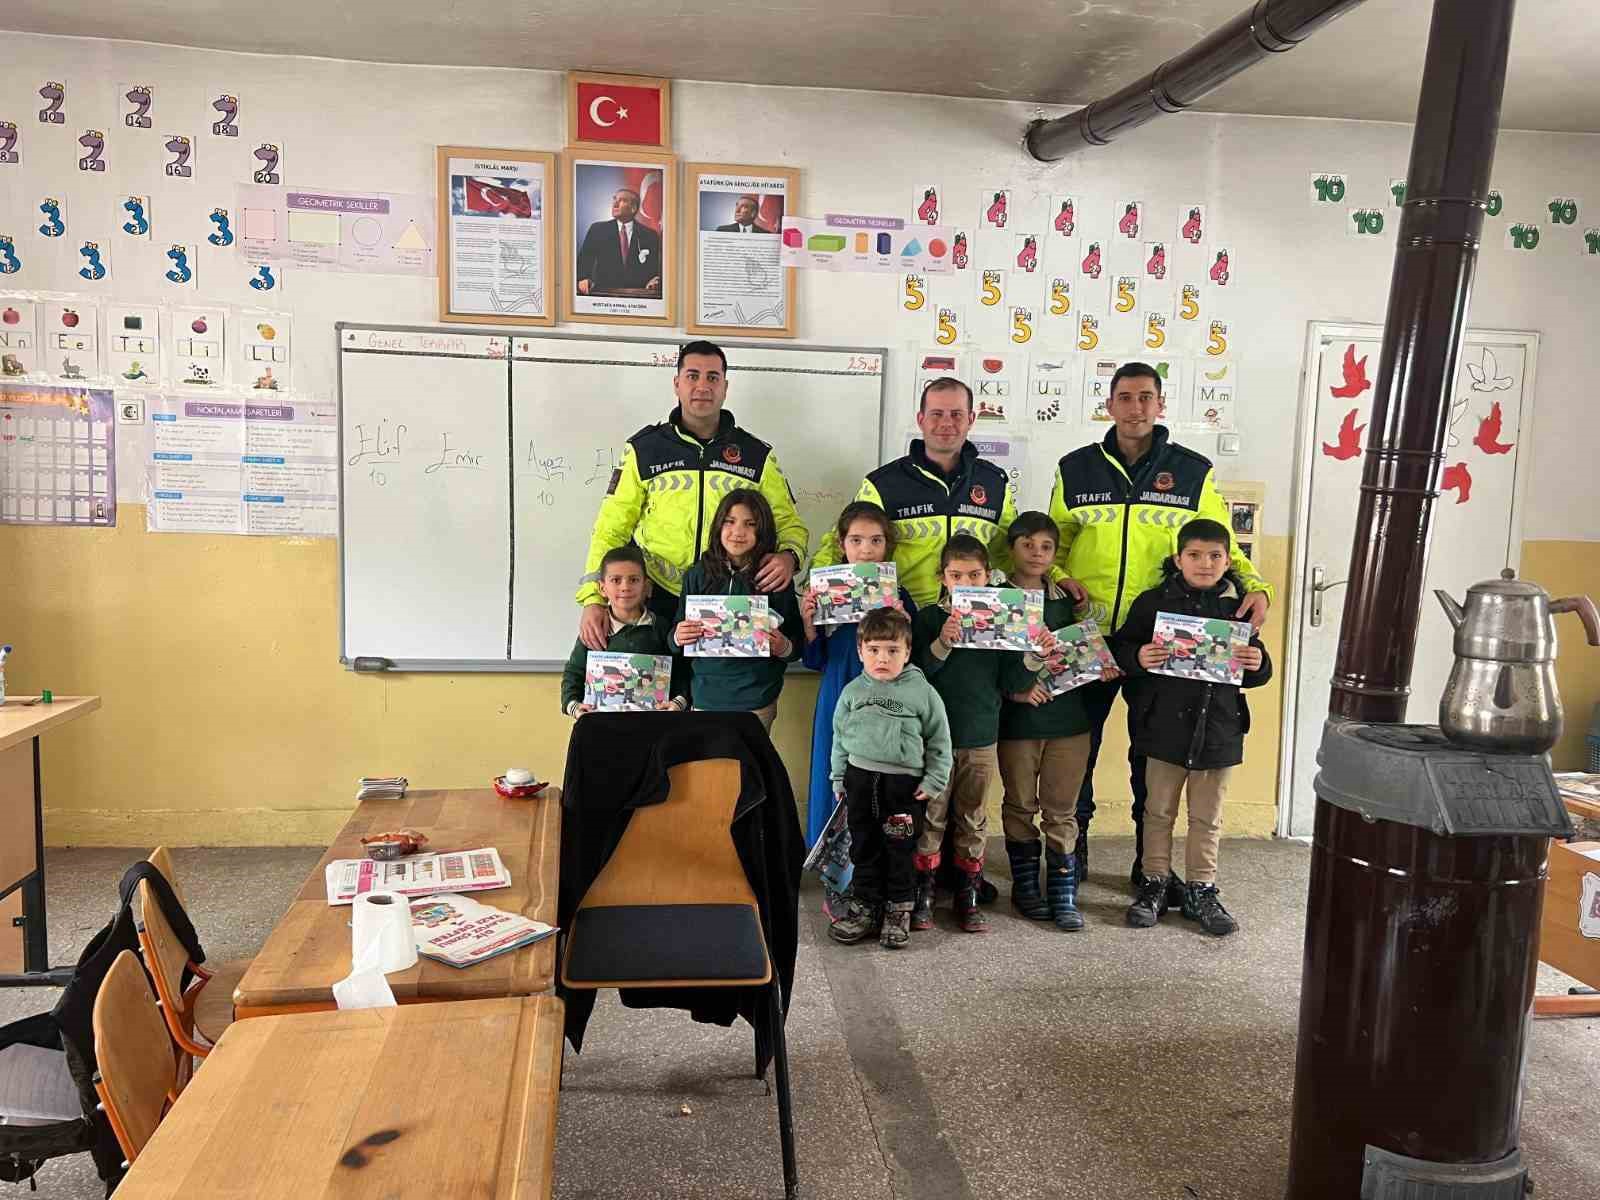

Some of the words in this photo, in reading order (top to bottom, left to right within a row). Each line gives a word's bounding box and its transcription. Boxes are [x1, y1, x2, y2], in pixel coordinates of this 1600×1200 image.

[44, 112, 56, 121] 10
[129, 115, 141, 126] 14
[217, 125, 229, 135] 18
[85, 159, 96, 170] 12
[169, 165, 181, 176] 16
[1313, 175, 1345, 202] 10
[1391, 181, 1408, 207] 1
[1487, 190, 1502, 216] 0
[1549, 198, 1577, 224] 10
[1352, 209, 1384, 234] 10
[1510, 223, 1539, 249] 10
[18, 338, 26, 349] n
[58, 333, 67, 349] E
[76, 341, 84, 350] e
[120, 335, 129, 352] T
[138, 340, 144, 352] t
[980, 380, 989, 396] K
[996, 381, 1004, 396] k
[1038, 380, 1049, 395] U
[1054, 387, 1062, 396] u
[1201, 386, 1215, 401] M
[1220, 392, 1230, 401] m
[349, 419, 407, 466] Elif
[536, 489, 555, 506] 10
[1075, 491, 1112, 504] TRAFİK
[1139, 490, 1190, 506] JANDARMASI
[897, 503, 935, 518] TRAFİK
